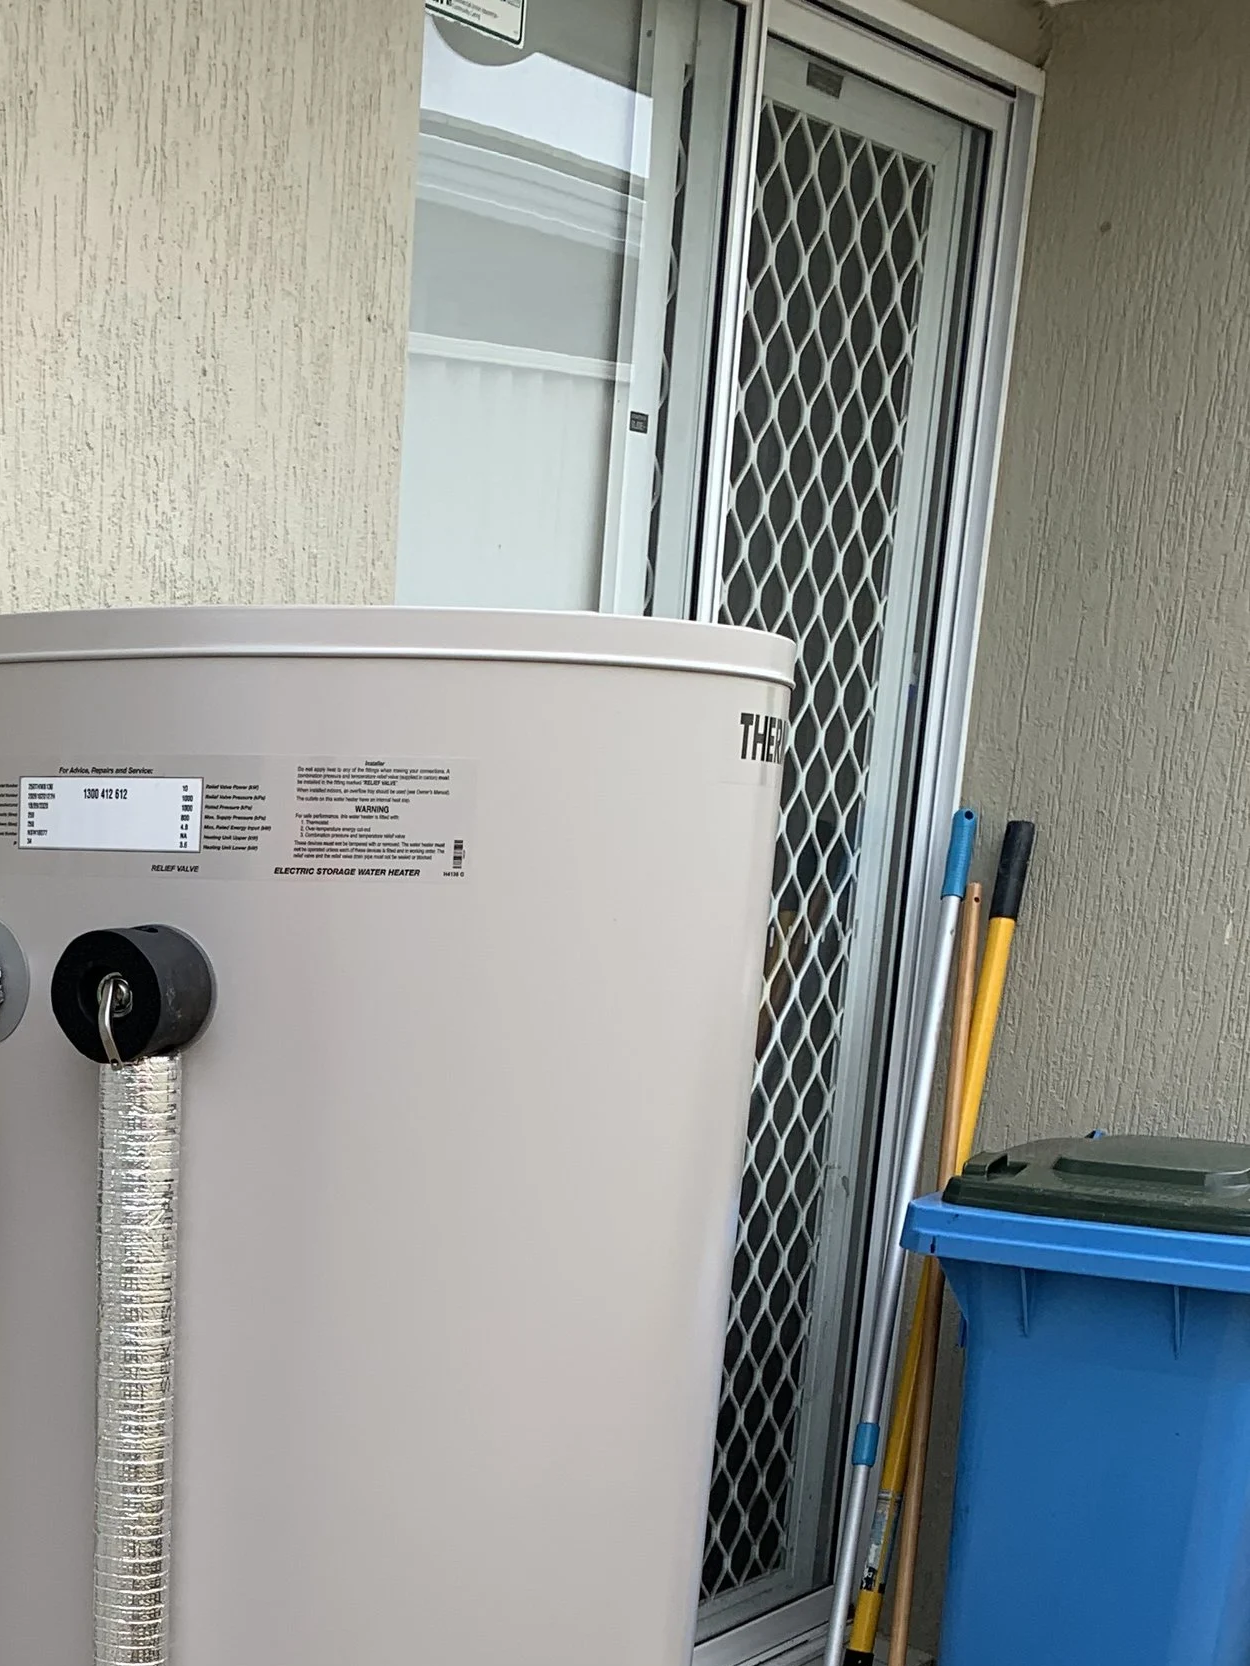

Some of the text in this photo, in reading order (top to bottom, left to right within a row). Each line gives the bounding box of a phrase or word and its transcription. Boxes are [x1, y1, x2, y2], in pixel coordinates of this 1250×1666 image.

[91, 767, 114, 775] Repairs
[83, 788, 128, 800] 1300 412 612
[355, 805, 389, 813] WARNING
[151, 864, 200, 873] RELIEF VALVE
[274, 867, 421, 877] ELECTRIC STORAGE WATER HEATER
